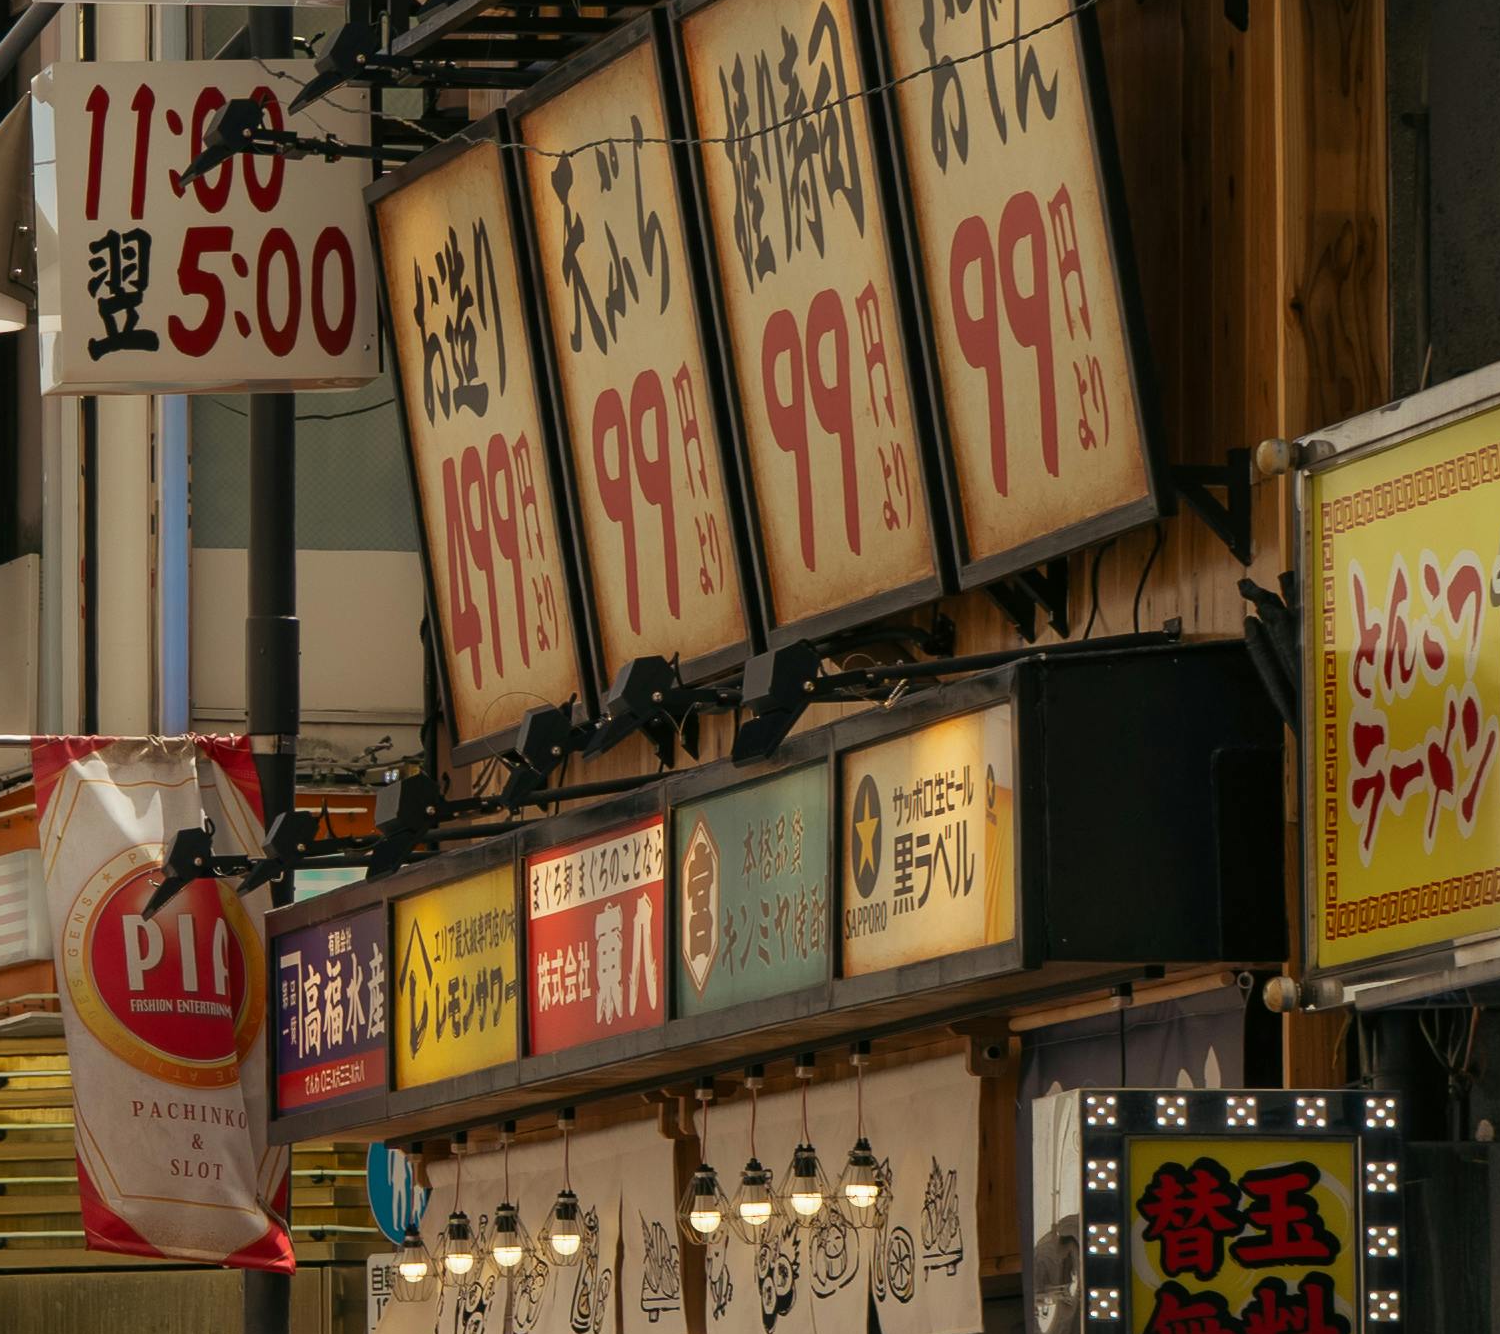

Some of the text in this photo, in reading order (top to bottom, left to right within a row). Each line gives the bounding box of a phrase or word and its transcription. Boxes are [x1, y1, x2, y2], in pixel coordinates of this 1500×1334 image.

[551, 114, 671, 355] 天ぷら
[412, 216, 508, 426] お造り
[1351, 559, 1484, 704] とんこつ
[893, 765, 974, 827] サッポロ生ビール
[1350, 682, 1497, 857] ラーメン
[892, 819, 975, 916] 黒ラベル
[844, 901, 887, 941] SAPPORO
[130, 997, 174, 1014] FASHION
[303, 942, 386, 1057] 高福水産
[434, 966, 520, 1044] レモンサワー
[537, 941, 592, 1014] 株式会社
[131, 1099, 249, 1131] PACHINKO
[191, 1133, 205, 1152] &
[169, 1158, 225, 1182] SLOT
[1136, 1157, 1341, 1281] 替玉
